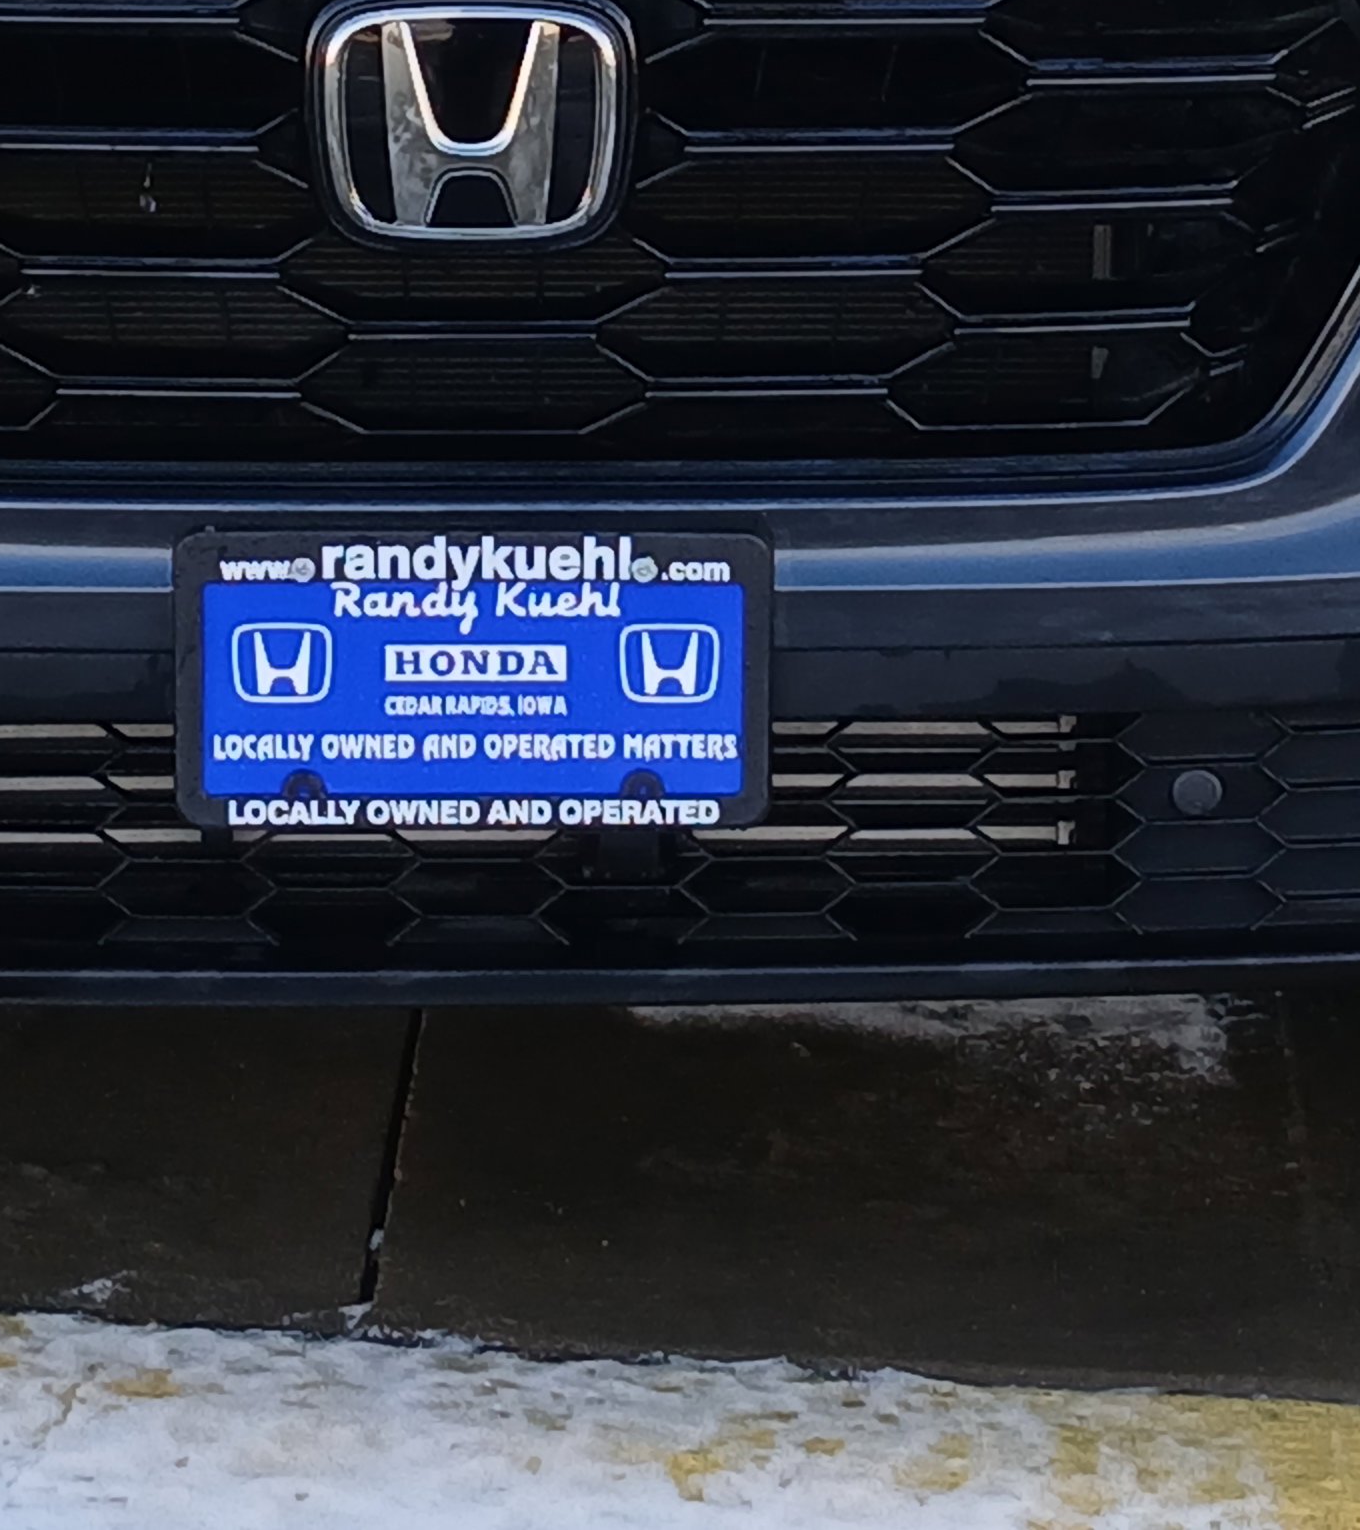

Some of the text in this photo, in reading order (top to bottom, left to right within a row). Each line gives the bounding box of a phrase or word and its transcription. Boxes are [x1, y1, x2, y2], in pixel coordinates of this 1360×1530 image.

[321, 536, 632, 591] randykuehl
[661, 561, 731, 582] .com
[330, 581, 622, 635] Randy Kuehl
[395, 650, 559, 676] HONDA
[384, 695, 442, 716] CEDAR
[517, 694, 568, 716] IOWA
[213, 733, 739, 762] LOCALLY OWNED AND OPERATED MATTERS
[228, 799, 721, 826] LOCALLY OWNED AND OPERATED
